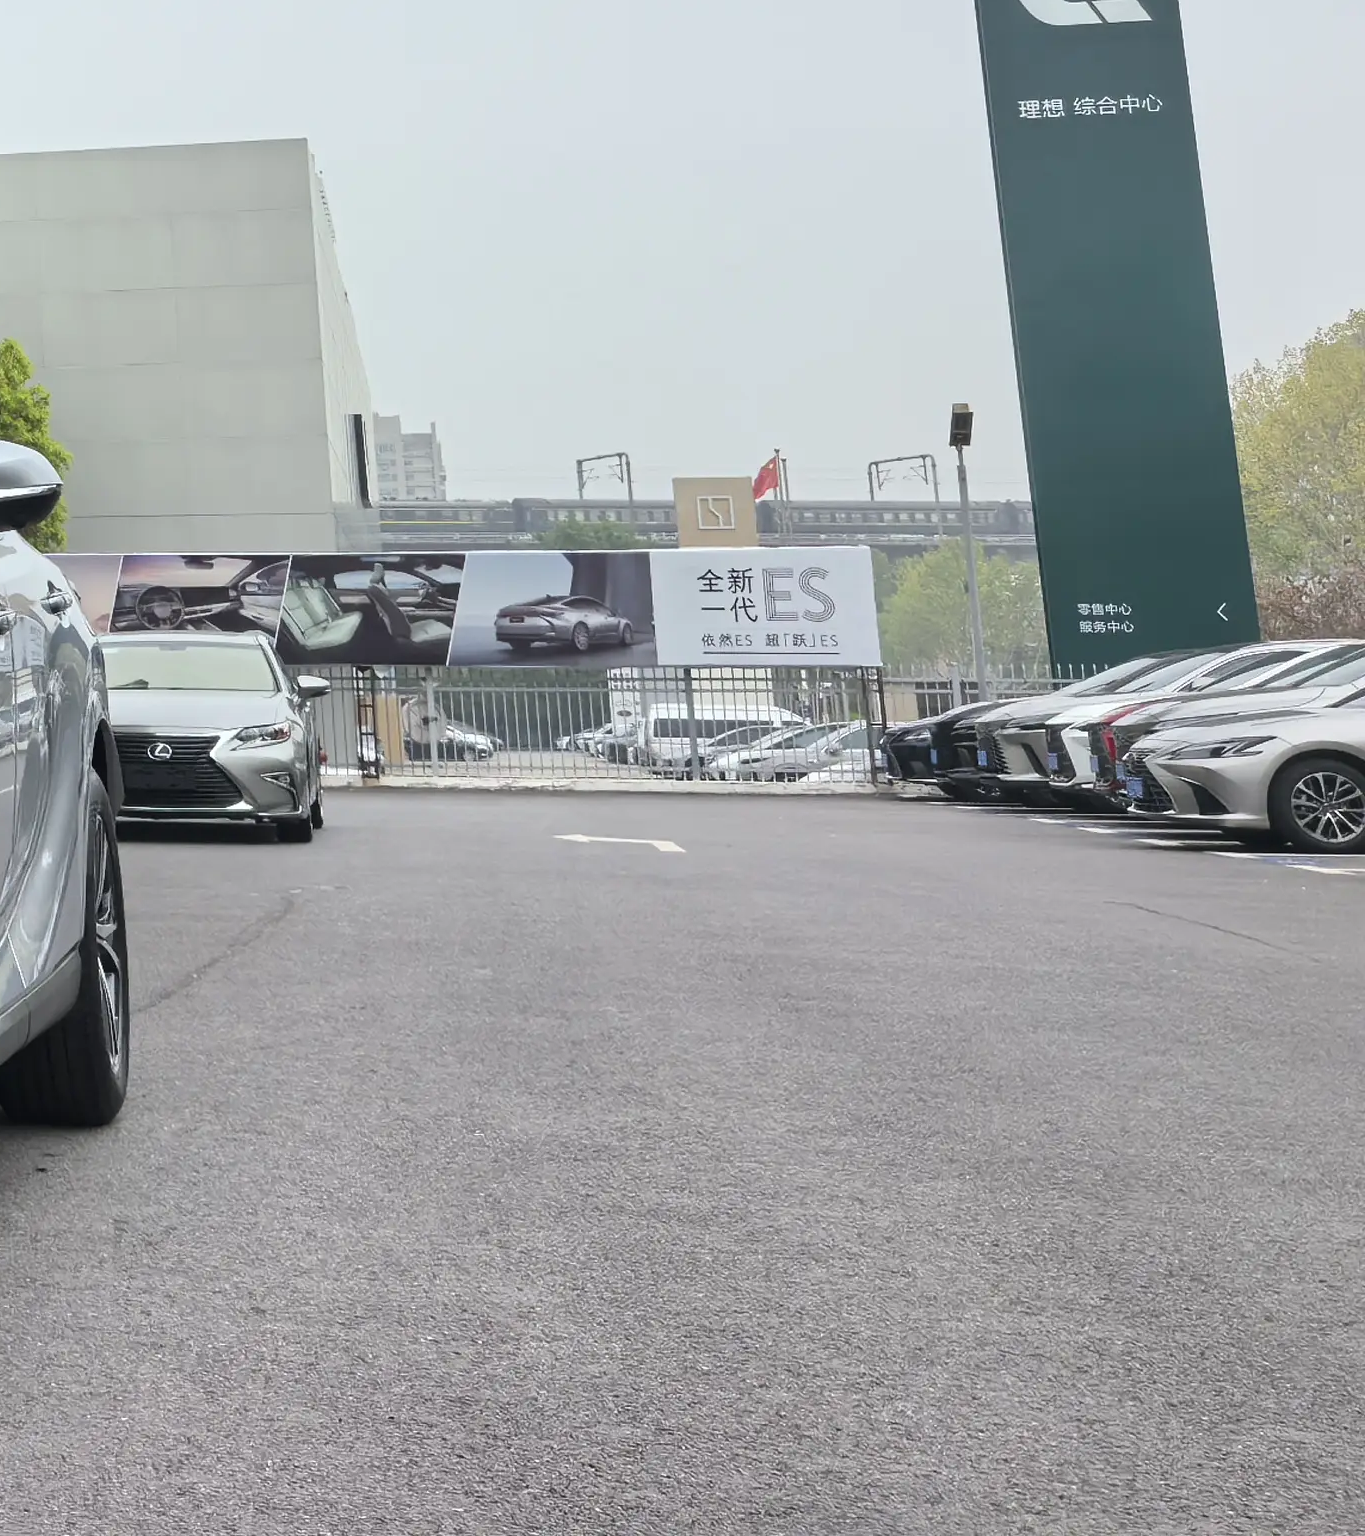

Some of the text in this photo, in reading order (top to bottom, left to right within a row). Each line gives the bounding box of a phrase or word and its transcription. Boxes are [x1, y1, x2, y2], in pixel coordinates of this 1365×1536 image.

[1017, 94, 1164, 119] 理想 综合中心
[697, 566, 836, 623] 全新 ES
[701, 596, 759, 623] 一代
[1079, 620, 1135, 633] 服务中心
